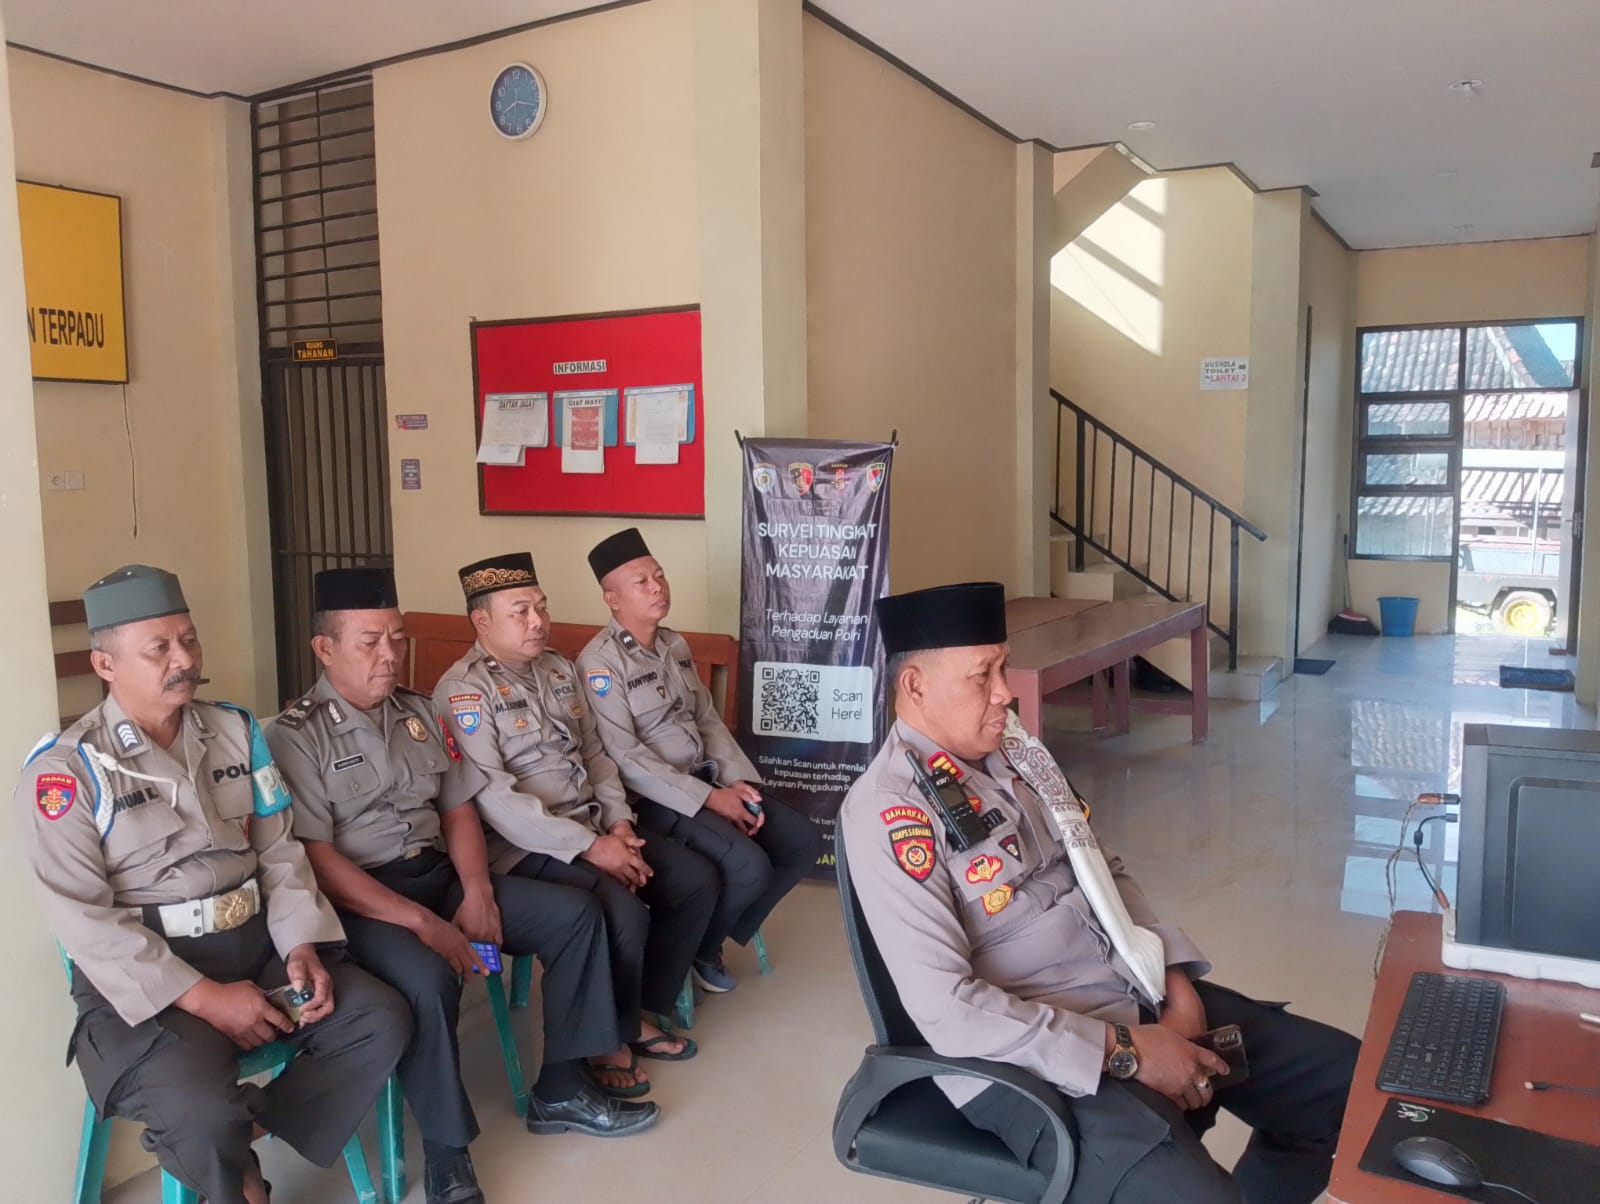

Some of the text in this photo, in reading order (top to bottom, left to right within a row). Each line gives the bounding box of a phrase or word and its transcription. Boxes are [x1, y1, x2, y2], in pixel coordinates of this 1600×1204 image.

[512, 69, 520, 80] 12
[497, 86, 506, 97] 10
[500, 115, 506, 125] 8
[39, 308, 104, 348] TERPADU
[297, 348, 334, 359] TAHANAN
[554, 361, 606, 373] INFORMASI
[1211, 374, 1239, 382] LANTAI
[758, 522, 877, 540] SURVEI TINGKAT
[766, 563, 868, 580] MASYARAKAT
[766, 608, 868, 626] Terhadap Layanan
[771, 626, 862, 641] Pengaduan Polri
[832, 688, 863, 703] Scan
[831, 707, 862, 720] Here!
[758, 756, 866, 773] Silahkan Scan untuk menilai
[774, 767, 851, 783] kepuasan terhadap
[763, 777, 797, 789] Layanan
[797, 781, 843, 793] Pengaduan
[885, 808, 929, 825] BAHARKAM
